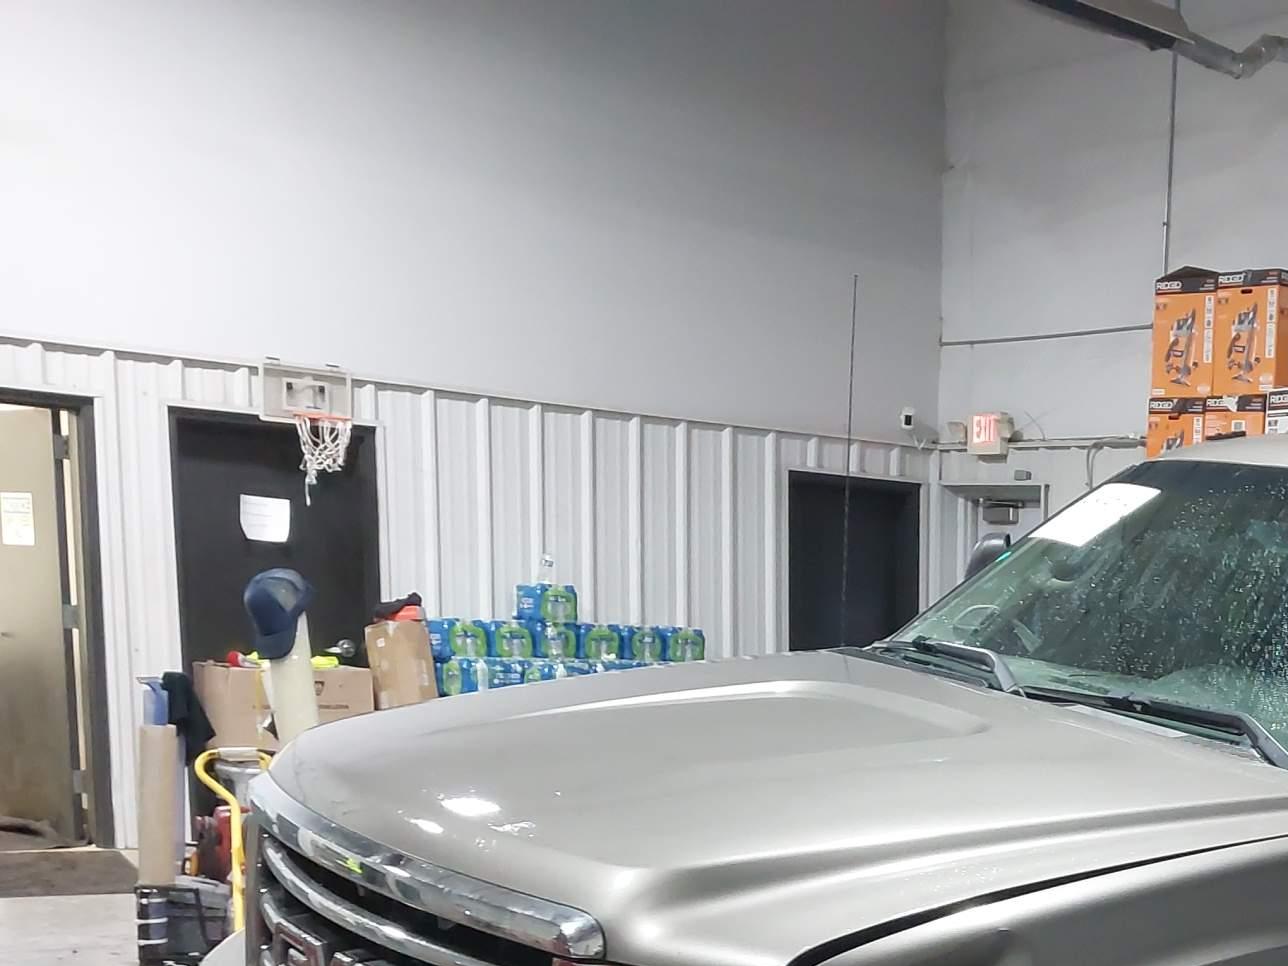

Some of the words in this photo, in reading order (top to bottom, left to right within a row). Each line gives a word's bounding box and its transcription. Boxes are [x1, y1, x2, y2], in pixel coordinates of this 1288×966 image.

[1218, 272, 1245, 283] RIDGID
[1156, 281, 1182, 290] RIDGID
[973, 415, 997, 443] EXIT
